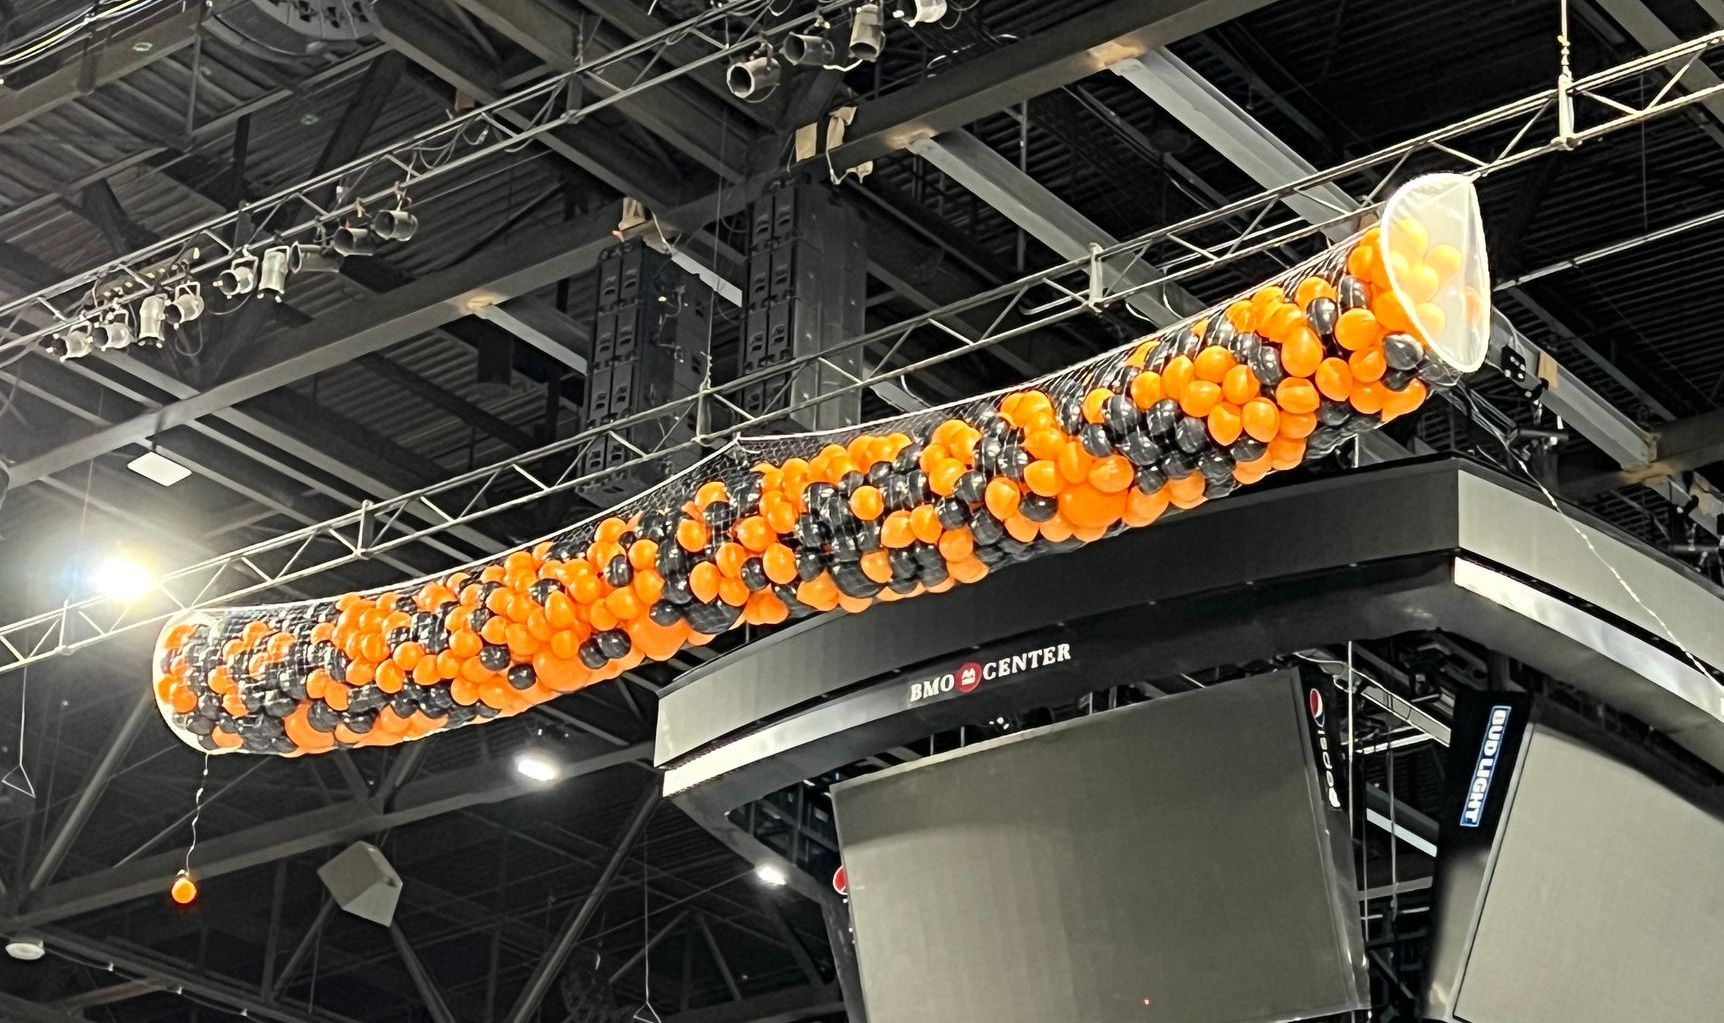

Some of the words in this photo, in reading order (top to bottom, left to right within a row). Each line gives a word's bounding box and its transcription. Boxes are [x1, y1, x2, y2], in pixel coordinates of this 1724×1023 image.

[910, 674, 955, 702] BMO
[983, 643, 1071, 681] CENTER
[1484, 709, 1507, 757] BUD
[1465, 758, 1494, 824] LIGHT
